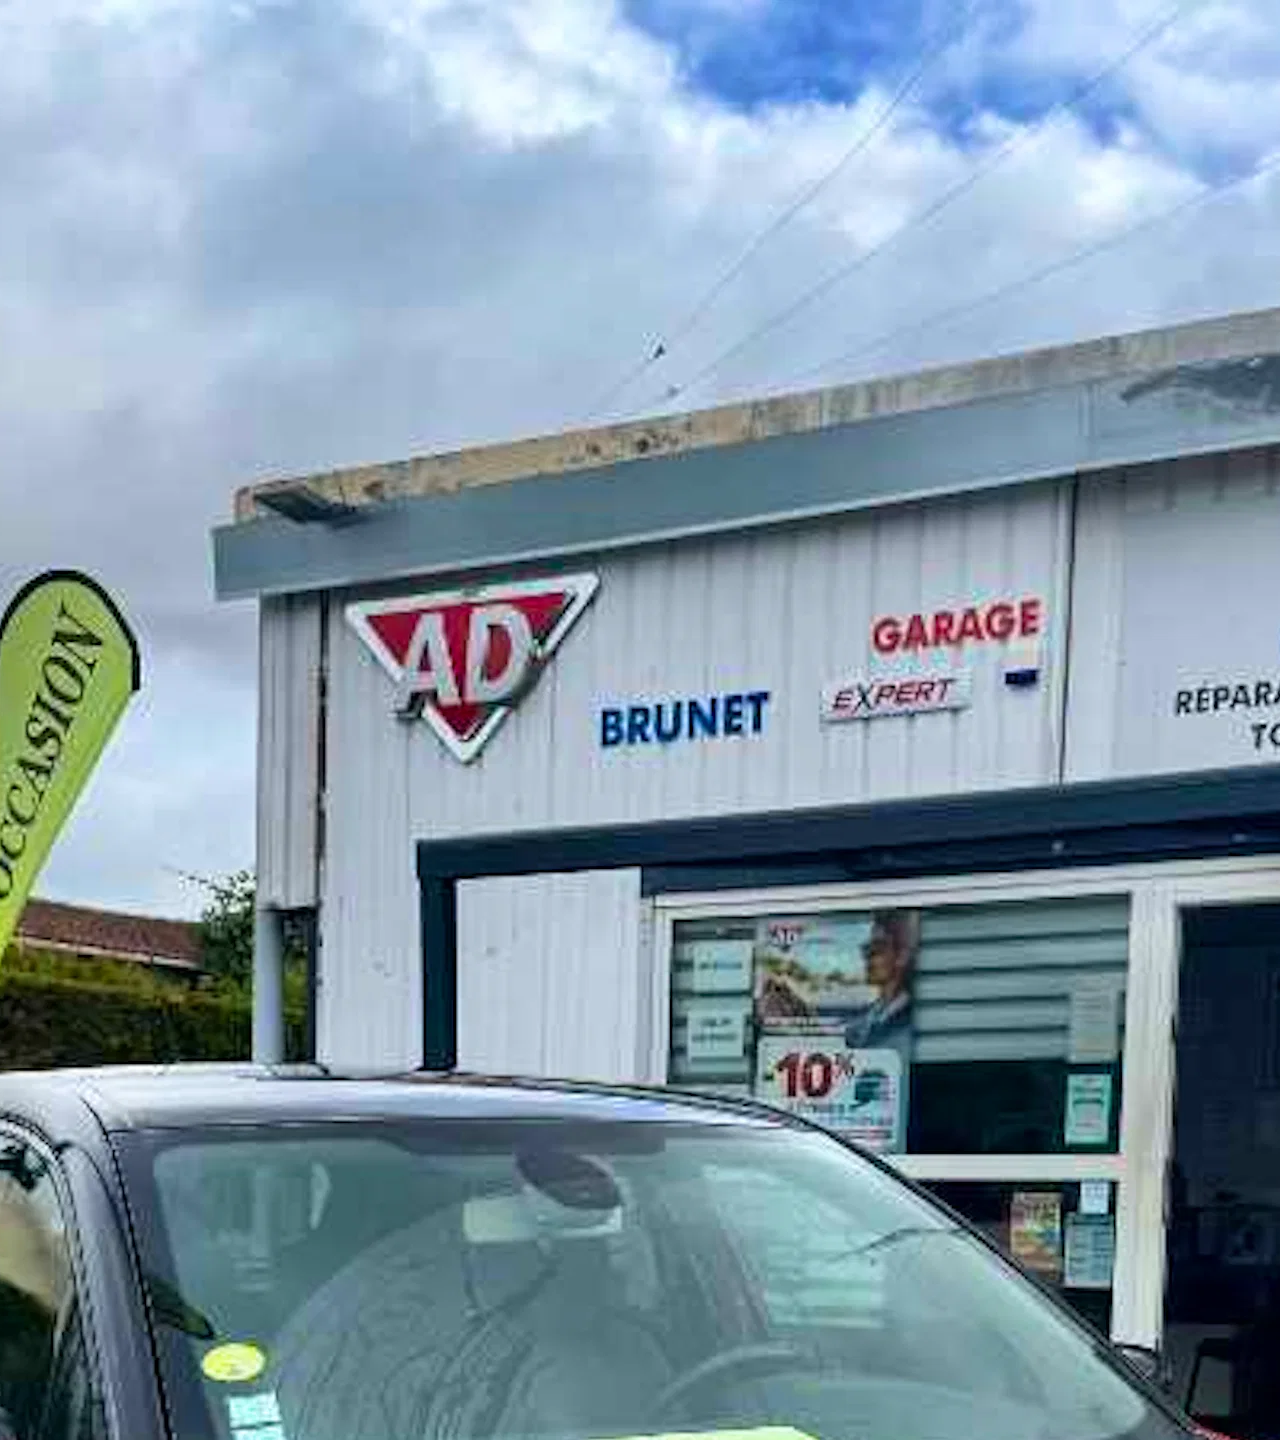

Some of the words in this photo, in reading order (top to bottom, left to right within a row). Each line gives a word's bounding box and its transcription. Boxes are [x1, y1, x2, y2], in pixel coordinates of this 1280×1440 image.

[872, 597, 1044, 655] GARAGE
[397, 604, 538, 710] AD
[600, 689, 770, 748] BRUNET
[831, 678, 959, 712] EXPERT
